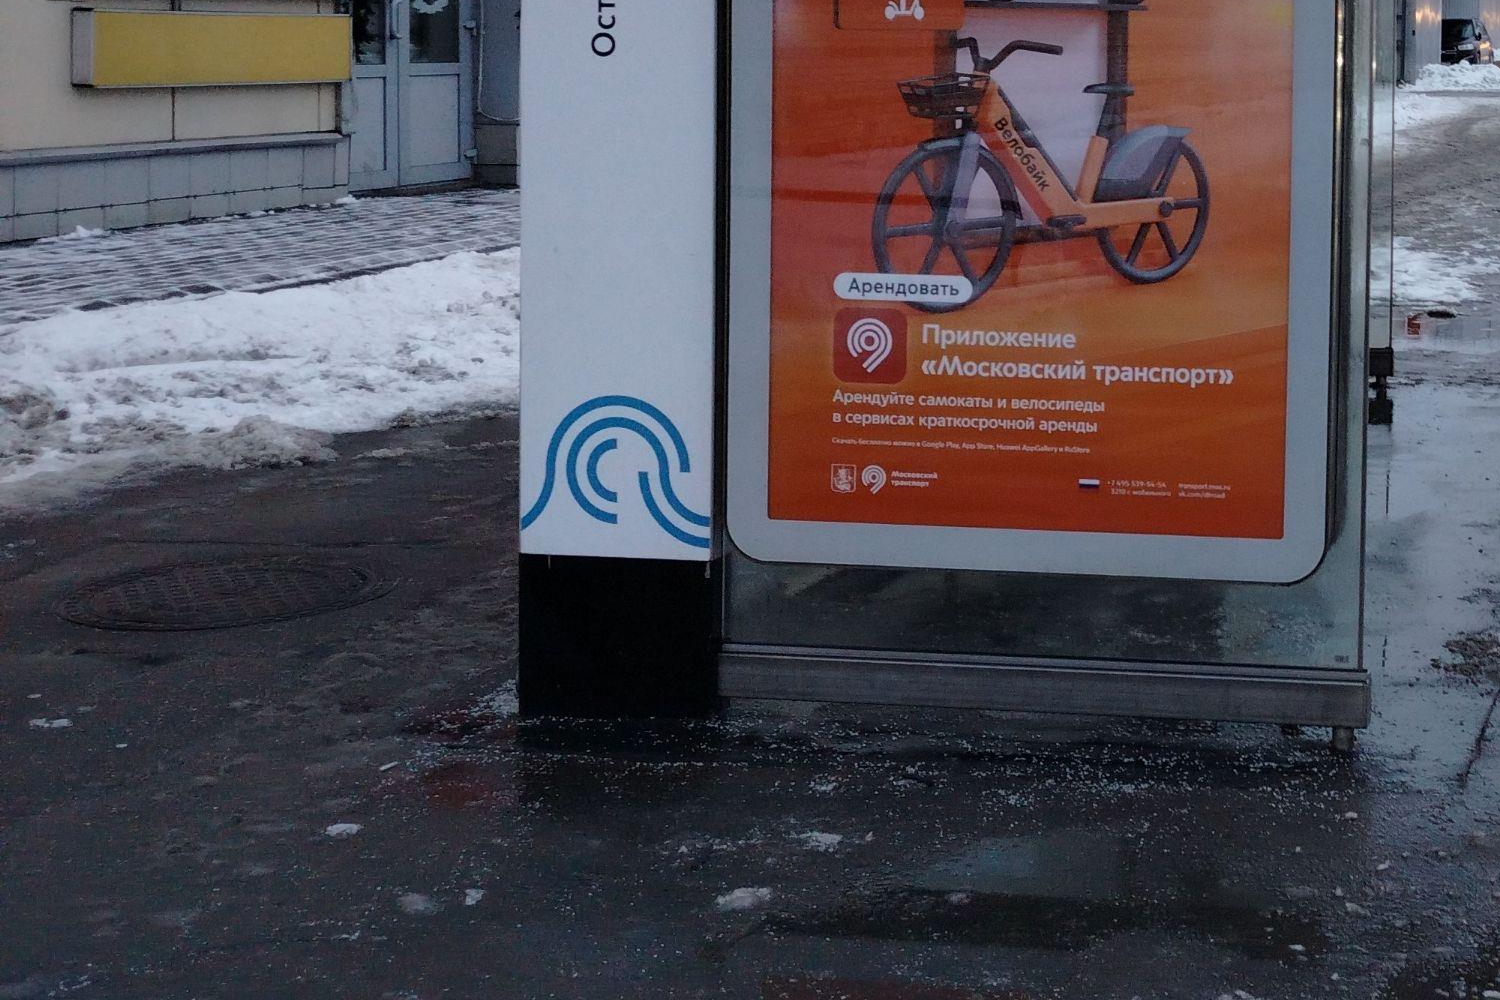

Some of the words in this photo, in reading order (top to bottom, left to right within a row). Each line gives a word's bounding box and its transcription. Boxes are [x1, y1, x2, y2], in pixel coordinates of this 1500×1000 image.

[994, 117, 1050, 192] Велобайк
[847, 277, 960, 297] Арендовать
[921, 323, 1077, 350] Приложение
[921, 355, 1086, 380] «Московский
[1093, 364, 1234, 388] транспорт»
[832, 389, 915, 408] Арендуйте
[918, 395, 993, 408] самокаты
[997, 398, 1007, 408] и
[1011, 398, 1105, 413] велосипеды
[832, 412, 841, 423] в
[845, 412, 915, 427] сервисах
[918, 415, 1035, 431] краткосрочной
[1038, 420, 1098, 434] аренды
[891, 470, 938, 479] Московский
[891, 480, 929, 488] транспорт
